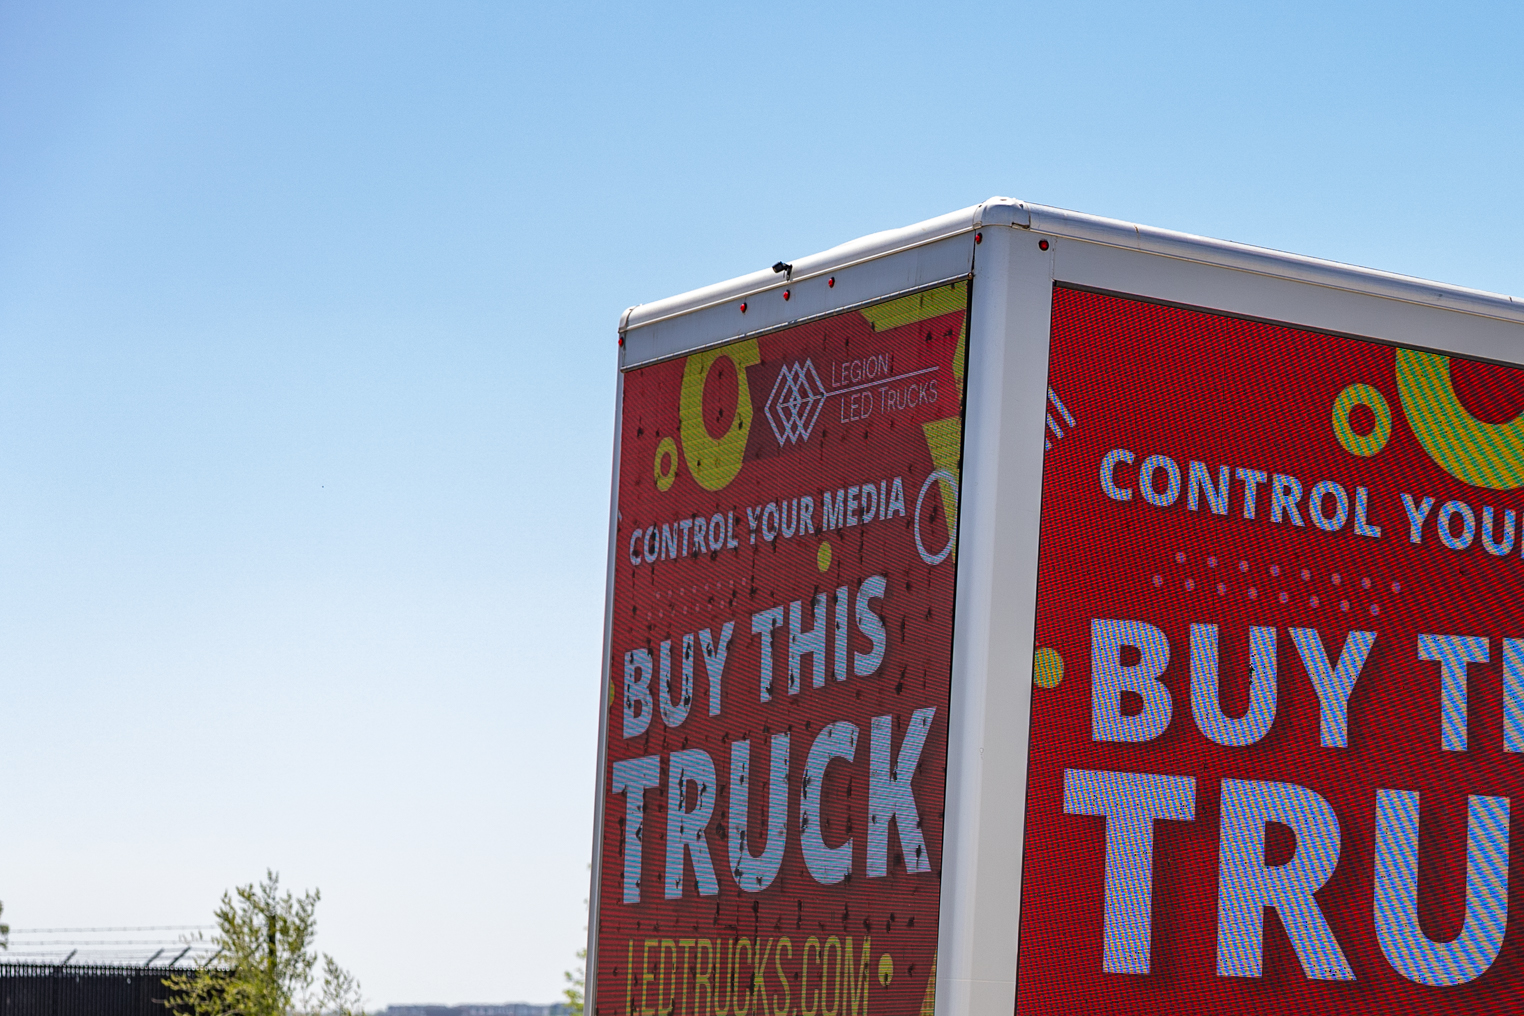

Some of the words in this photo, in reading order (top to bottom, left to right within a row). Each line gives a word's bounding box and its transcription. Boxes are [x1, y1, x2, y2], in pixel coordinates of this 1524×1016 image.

[831, 352, 889, 388] LEGION
[839, 391, 873, 424] LED
[879, 380, 939, 416] TRUCKS
[629, 512, 738, 566] CONTROL
[746, 495, 815, 546] YOUR
[822, 476, 906, 532] MEDIA
[1099, 448, 1382, 538] CONTROL
[622, 620, 735, 739] BUY
[751, 574, 888, 704] THIS
[1089, 617, 1378, 750] BUY
[611, 706, 938, 905] TRUCK
